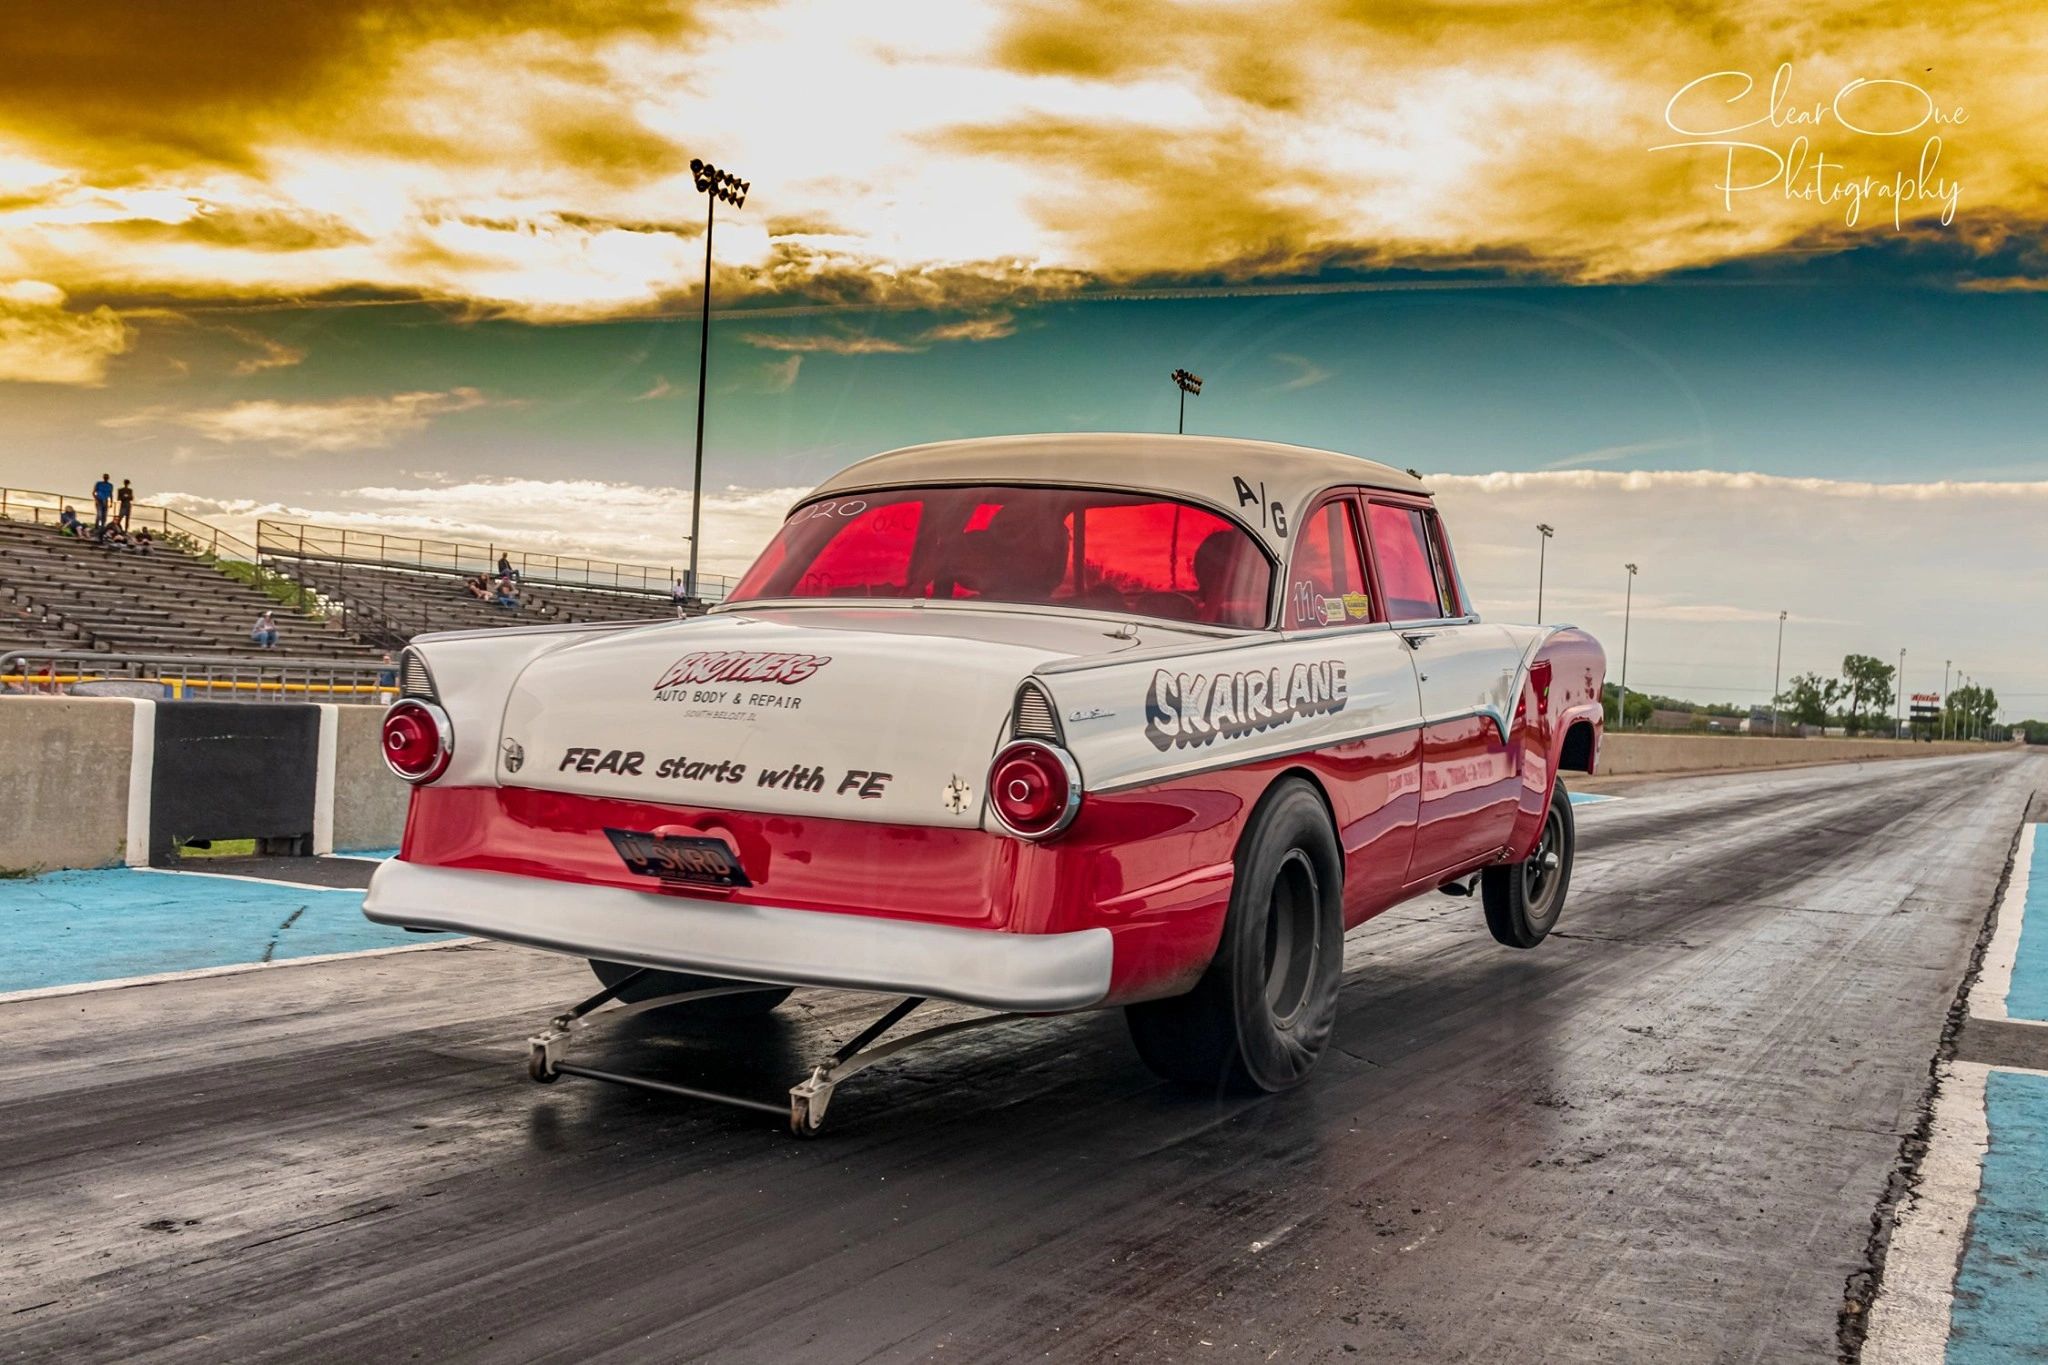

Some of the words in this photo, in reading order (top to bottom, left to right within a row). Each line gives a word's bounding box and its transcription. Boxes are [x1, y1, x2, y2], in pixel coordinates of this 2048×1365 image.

[653, 650, 832, 690] BROTHERS
[654, 689, 687, 702] AUTO
[694, 690, 727, 704] BODY
[733, 692, 741, 705] &
[749, 693, 802, 709] REPAIR
[1144, 660, 1350, 752] SKAIRLANE
[558, 747, 645, 777] FEAR
[655, 756, 746, 784] starts
[757, 764, 824, 793] with
[836, 770, 893, 800] FE
